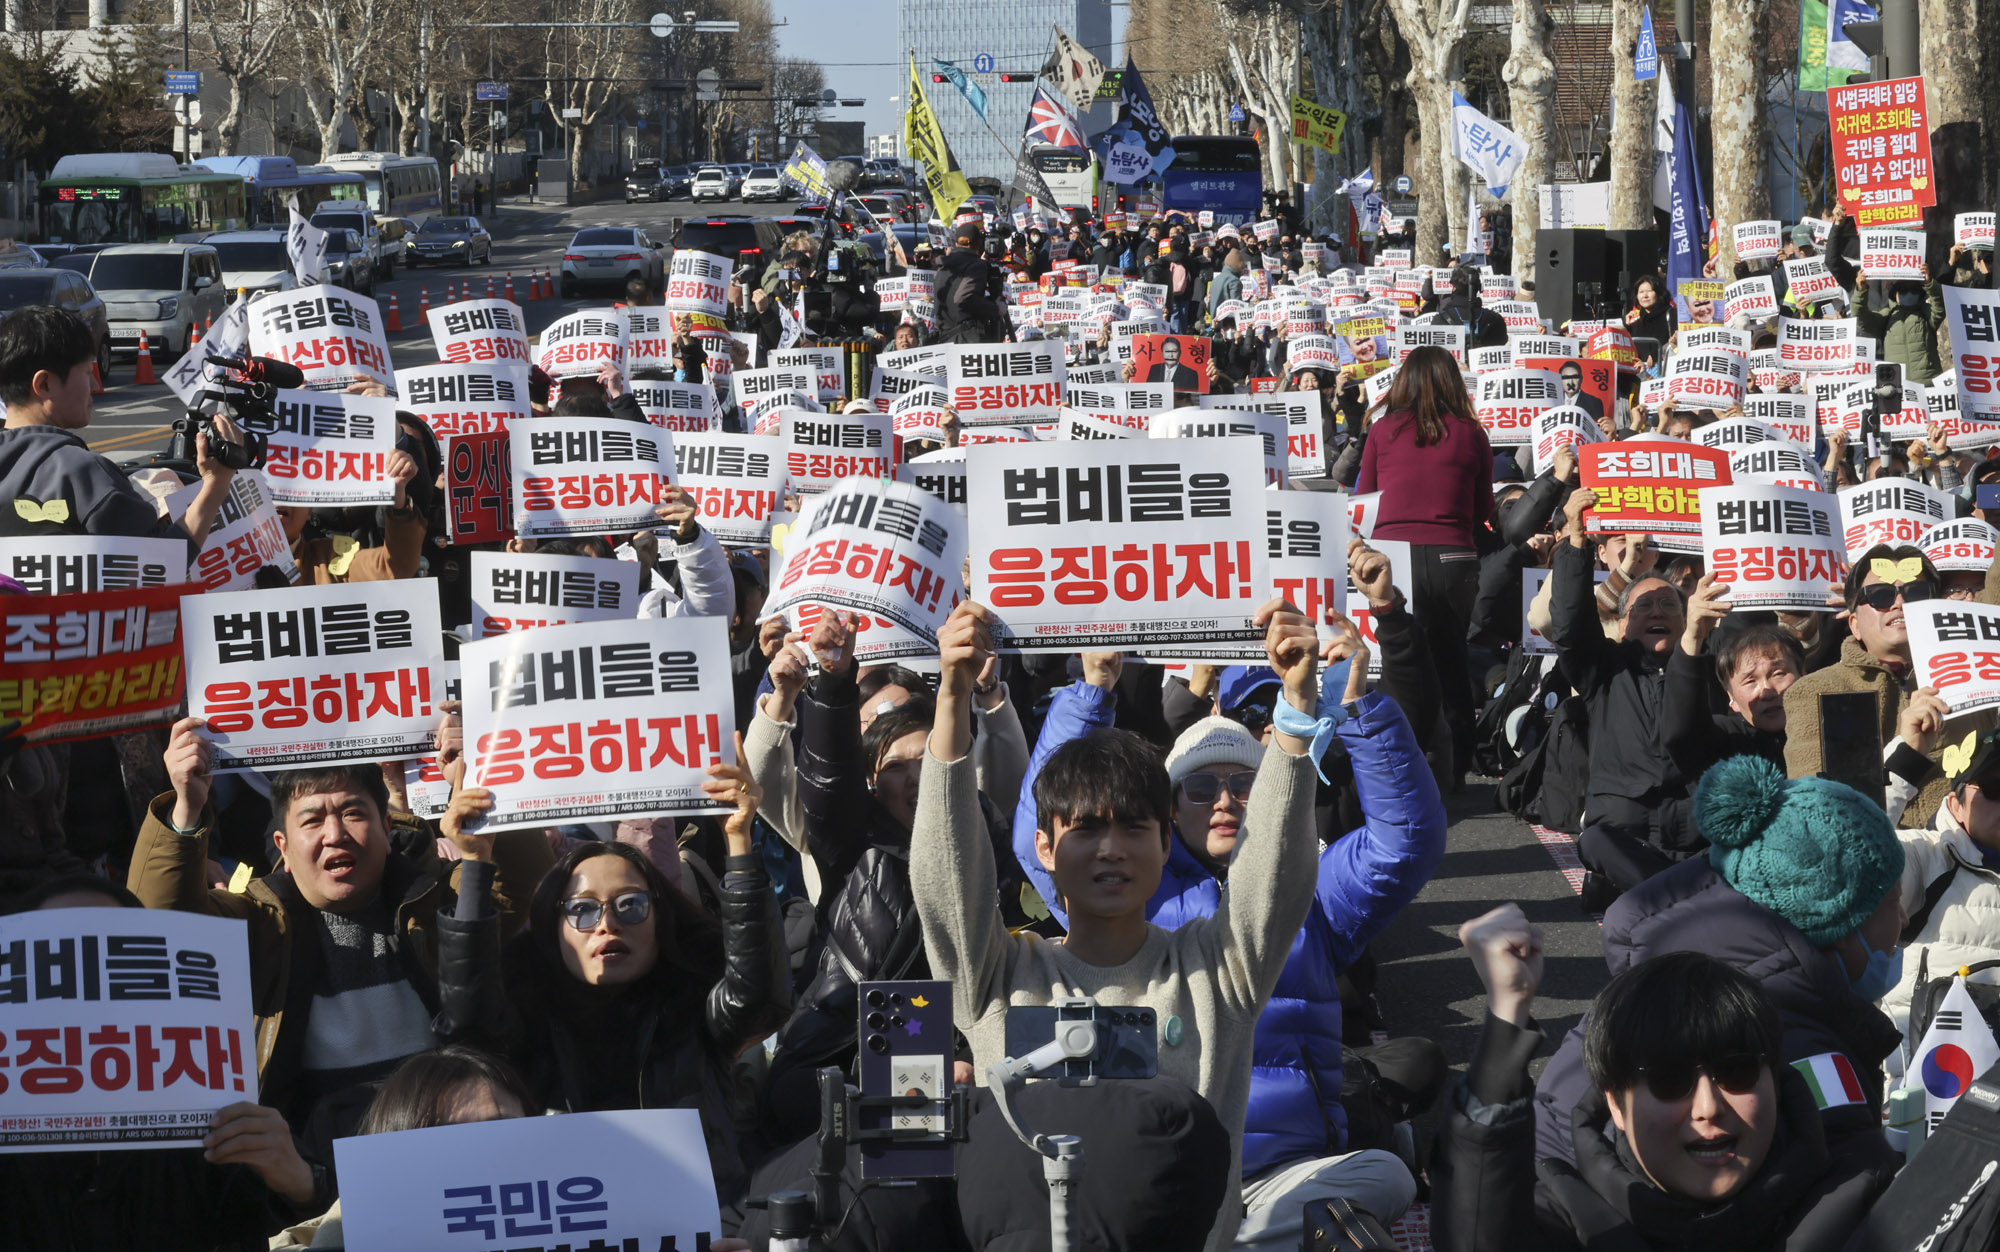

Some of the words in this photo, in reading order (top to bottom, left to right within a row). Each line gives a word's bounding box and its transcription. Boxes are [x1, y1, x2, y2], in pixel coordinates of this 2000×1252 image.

[1836, 85, 1893, 112] 사법쿠테타
[1894, 82, 1917, 105] 일당
[1836, 108, 1922, 135] 지귀연.조희대는
[1462, 120, 1512, 166] 탐사
[1846, 136, 1886, 160] 국민을
[1890, 132, 1917, 154] 절대
[1110, 150, 1150, 170] 뉴탐사
[1842, 163, 1867, 186] 이길
[1872, 162, 1886, 178] 수
[1888, 158, 1927, 182] 없다!!
[1861, 188, 1914, 205] 조희대를
[1858, 205, 1919, 224] 탄핵하라!
[1964, 216, 1996, 226] 법비
[1736, 238, 1780, 252] 응징하자!
[1867, 235, 1918, 251] 법비들을
[1863, 254, 1921, 270] 응징하자!
[874, 282, 904, 292] 비들을
[262, 297, 372, 335] 국힘당을
[444, 307, 520, 336] 법비들을
[1502, 315, 1537, 327] 징하자!
[548, 318, 619, 346] 법비들을
[1404, 331, 1456, 345] 법비들을
[1687, 331, 1742, 347] 법비들을
[1786, 324, 1847, 341] 법비들을
[540, 342, 623, 372] 응징하자!
[1519, 340, 1572, 356] 법비들을
[1780, 344, 1851, 361] 응징하자!
[961, 351, 1053, 379] 법비들을
[1676, 357, 1741, 378] 법비들을
[408, 374, 516, 405] 법비들을
[743, 373, 808, 395] 법비들을
[954, 381, 1061, 411] 응징하자!
[1484, 378, 1557, 402] 법비들을
[1669, 377, 1743, 400] 응징하자!
[632, 387, 702, 410] 법비들을
[244, 400, 375, 440] 비들을
[649, 413, 709, 433] 징하자!
[531, 430, 660, 466] 법비들을
[794, 420, 882, 449] 법비들을
[266, 444, 385, 482] 징하자!
[787, 453, 889, 479] 응징하자!
[1597, 451, 1717, 481] 조희대를
[523, 472, 673, 512] 응징하자!
[1003, 463, 1232, 527] 법비들을
[1852, 487, 1944, 521] 법비들을
[807, 494, 949, 559] 법비들을
[1717, 500, 1832, 537] 법비들을
[197, 516, 286, 592] 응징하자!
[1712, 546, 1847, 584] 응징하자!
[13, 554, 167, 597] 법비들을
[492, 568, 621, 609] 법비들을
[779, 539, 946, 614] 응징하자!
[987, 540, 1253, 609] 응징하자!
[3, 605, 179, 664] 조희대를
[214, 602, 413, 665] 법비들을
[1034, 625, 1072, 636] 내란청산!
[1074, 623, 1128, 635] 국민주권실현!
[1130, 621, 1188, 633] 촛불대행진으로
[1190, 619, 1219, 630] 모이자!
[1144, 634, 1157, 642] ARS
[855, 643, 888, 654] 민주권실현!
[489, 642, 700, 713] 법비들을
[204, 667, 432, 734] 응징하자!
[280, 742, 327, 754] 국민주권실현!
[328, 738, 378, 750] 촛불대행진으로
[380, 736, 405, 746] 모이자!
[475, 714, 721, 788] 응징하자!
[665, 788, 692, 798] 모이자!
[0, 935, 222, 1005] 법비들을
[44, 1116, 106, 1129] 국민주권실현!
[109, 1114, 177, 1127] 촛불대행진으로
[179, 1112, 212, 1124] 모이자!
[125, 1130, 140, 1138] ARS
[443, 1176, 609, 1240] 국민은
